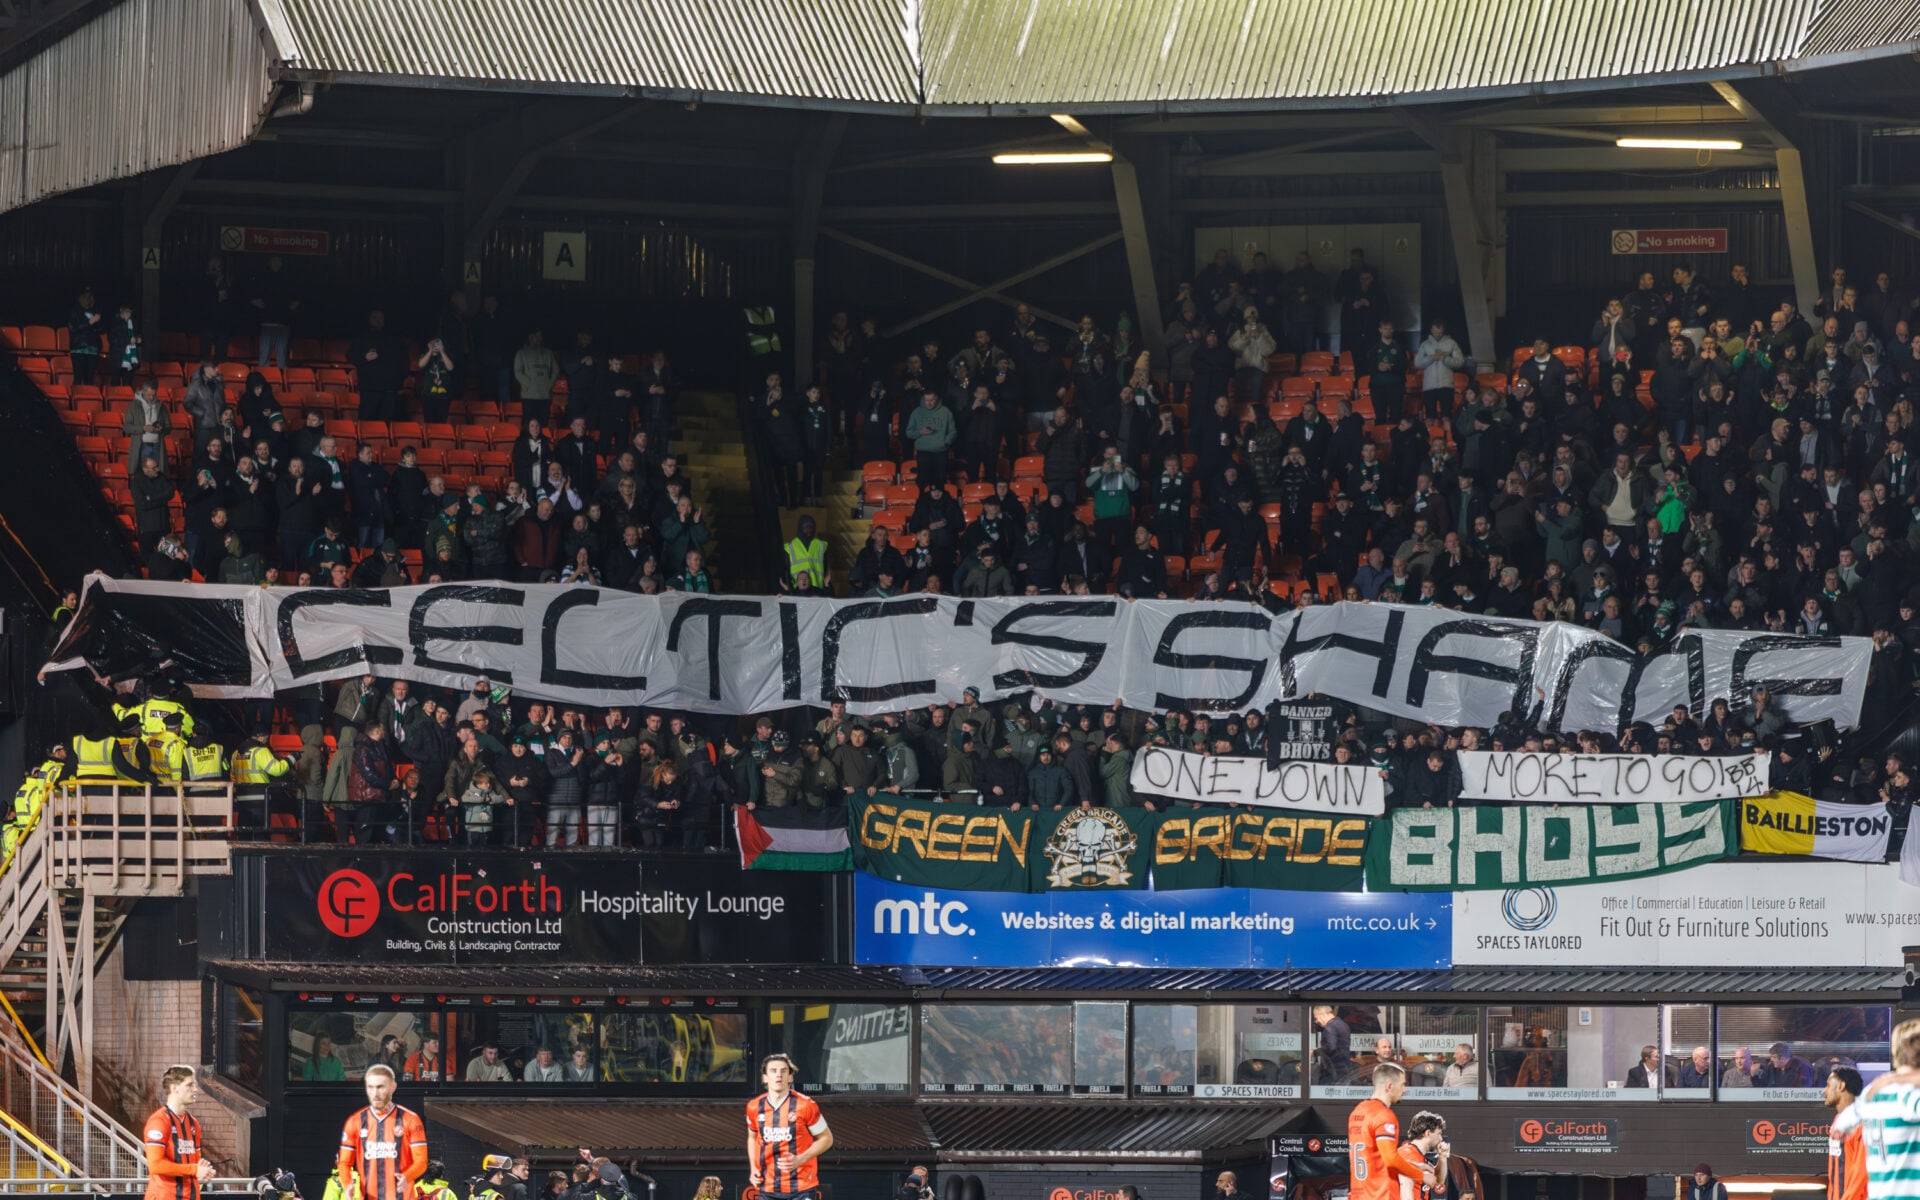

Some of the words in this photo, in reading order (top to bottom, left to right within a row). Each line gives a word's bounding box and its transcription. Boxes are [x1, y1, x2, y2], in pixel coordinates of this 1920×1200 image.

[254, 233, 269, 246] No
[272, 235, 320, 249] smoking
[1646, 235, 1662, 247] No
[1666, 234, 1715, 248] smoking
[143, 248, 158, 267] A
[556, 242, 574, 268] A
[465, 263, 479, 282] A
[1280, 704, 1332, 718] BANNED
[1279, 741, 1331, 760] BHOYS
[1144, 747, 1244, 796] ONE
[1256, 759, 1368, 806] DOWN
[1483, 752, 1601, 799] MORE
[1599, 755, 1651, 794] TO
[1662, 756, 1725, 798] GO!
[1745, 803, 1889, 837] BAILLIESTON
[860, 803, 1032, 870] GREEN
[1155, 813, 1366, 866] BRIGADE
[1389, 801, 1726, 885] BHOYS
[387, 872, 562, 912] CalForth
[580, 889, 699, 920] Hospitality
[706, 889, 785, 920] Lounge
[1601, 896, 1629, 911] Office
[1636, 896, 1690, 910] Commercial
[1698, 896, 1743, 910] Education
[1751, 896, 1785, 910] Leisure
[1788, 898, 1797, 910] &
[1799, 896, 1826, 910] Retail
[873, 892, 977, 936] mtc.
[1001, 911, 1095, 931] Websites
[1100, 912, 1116, 931] &
[1120, 911, 1185, 936] digital
[1190, 911, 1295, 936] marketing
[1327, 914, 1420, 931] mtc.co.uk
[427, 917, 532, 934] Construction
[536, 917, 562, 934] Ltd
[1600, 916, 1620, 937] Fit
[1626, 916, 1653, 937] Out
[1658, 917, 1671, 937] &
[1677, 916, 1750, 937] Furniture
[1755, 916, 1829, 938] Solutions
[386, 939, 422, 953] Building,
[424, 939, 447, 951] Civils
[449, 940, 457, 951] &
[459, 940, 512, 953] Landscaping
[514, 941, 561, 951] Contractor
[1476, 935, 1521, 950] SPACES
[1523, 935, 1582, 950] TAYLORED
[1221, 1087, 1251, 1097] SPACES
[1254, 1087, 1294, 1097] TAYLORED
[1527, 1089, 1617, 1099] www.spacestaylored.com
[1544, 1120, 1607, 1135] CalForth
[1777, 1122, 1831, 1135] CalFort
[1354, 1142, 1368, 1180] 6
